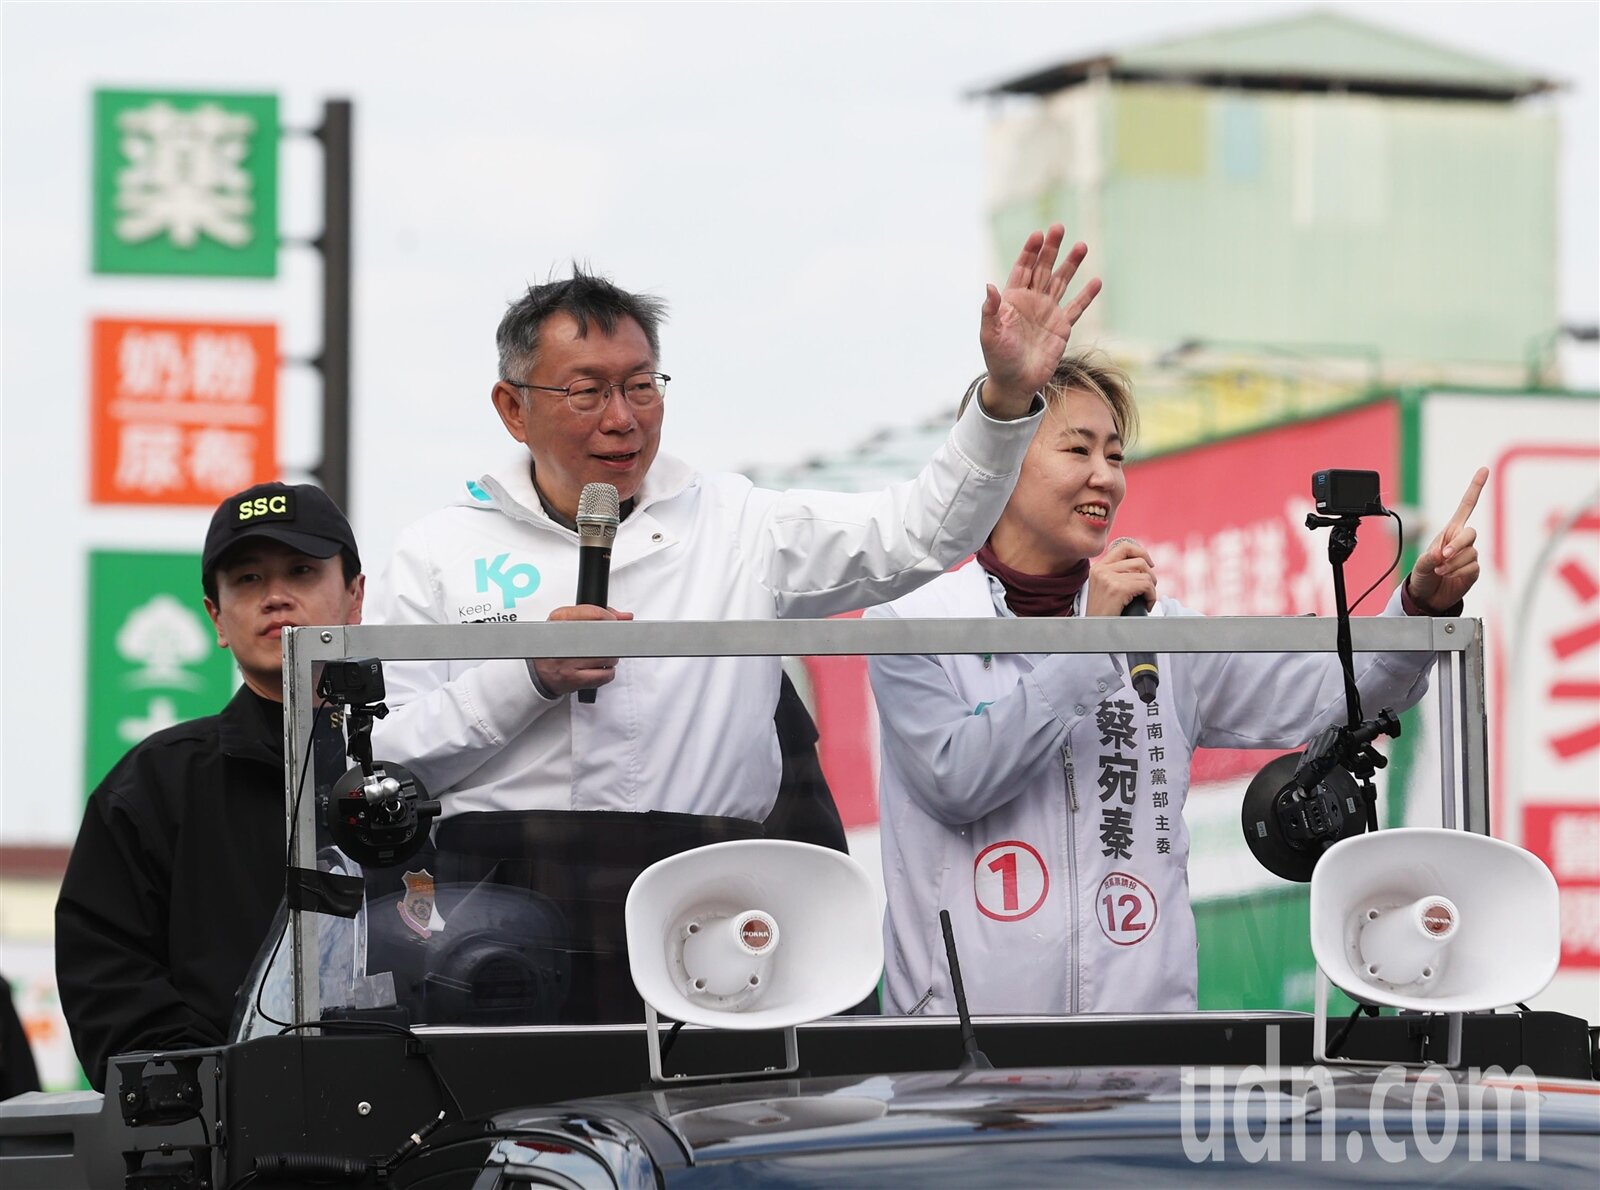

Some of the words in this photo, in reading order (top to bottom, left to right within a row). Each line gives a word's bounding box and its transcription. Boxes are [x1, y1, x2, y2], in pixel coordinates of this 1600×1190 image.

[239, 496, 286, 520] SSC
[458, 602, 492, 617] Keep
[1095, 699, 1138, 861] 蔡宛秦
[1145, 701, 1171, 855] 台南市黨部主委
[987, 852, 1019, 911] 1
[1102, 894, 1146, 932] 12
